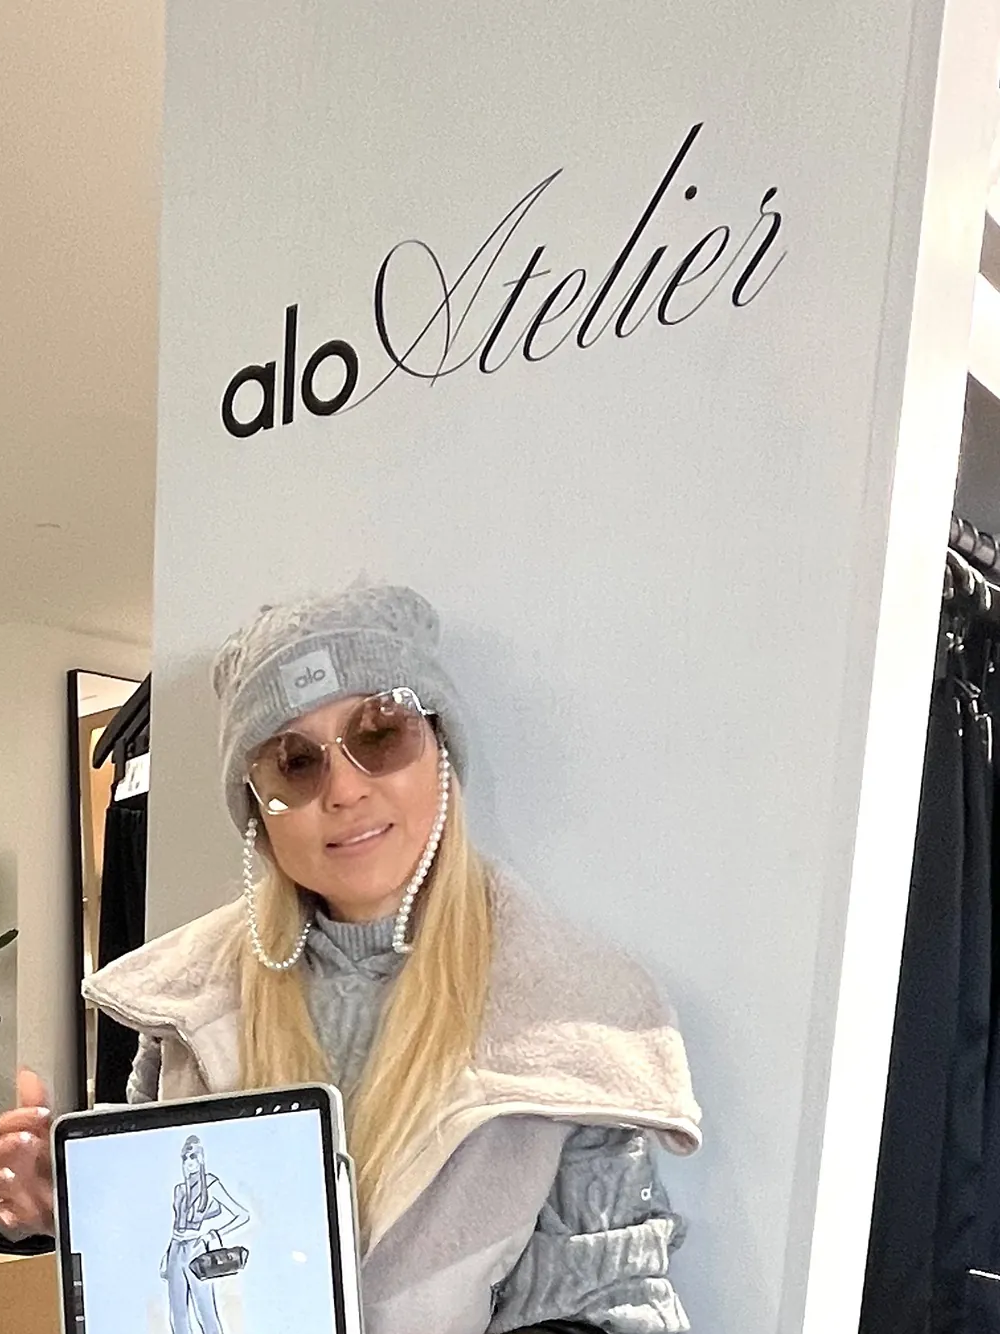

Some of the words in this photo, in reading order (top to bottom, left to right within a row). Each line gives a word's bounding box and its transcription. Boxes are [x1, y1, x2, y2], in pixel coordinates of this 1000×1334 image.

[221, 303, 360, 439] alo
[335, 121, 788, 416] Atelier
[295, 666, 326, 689] alo
